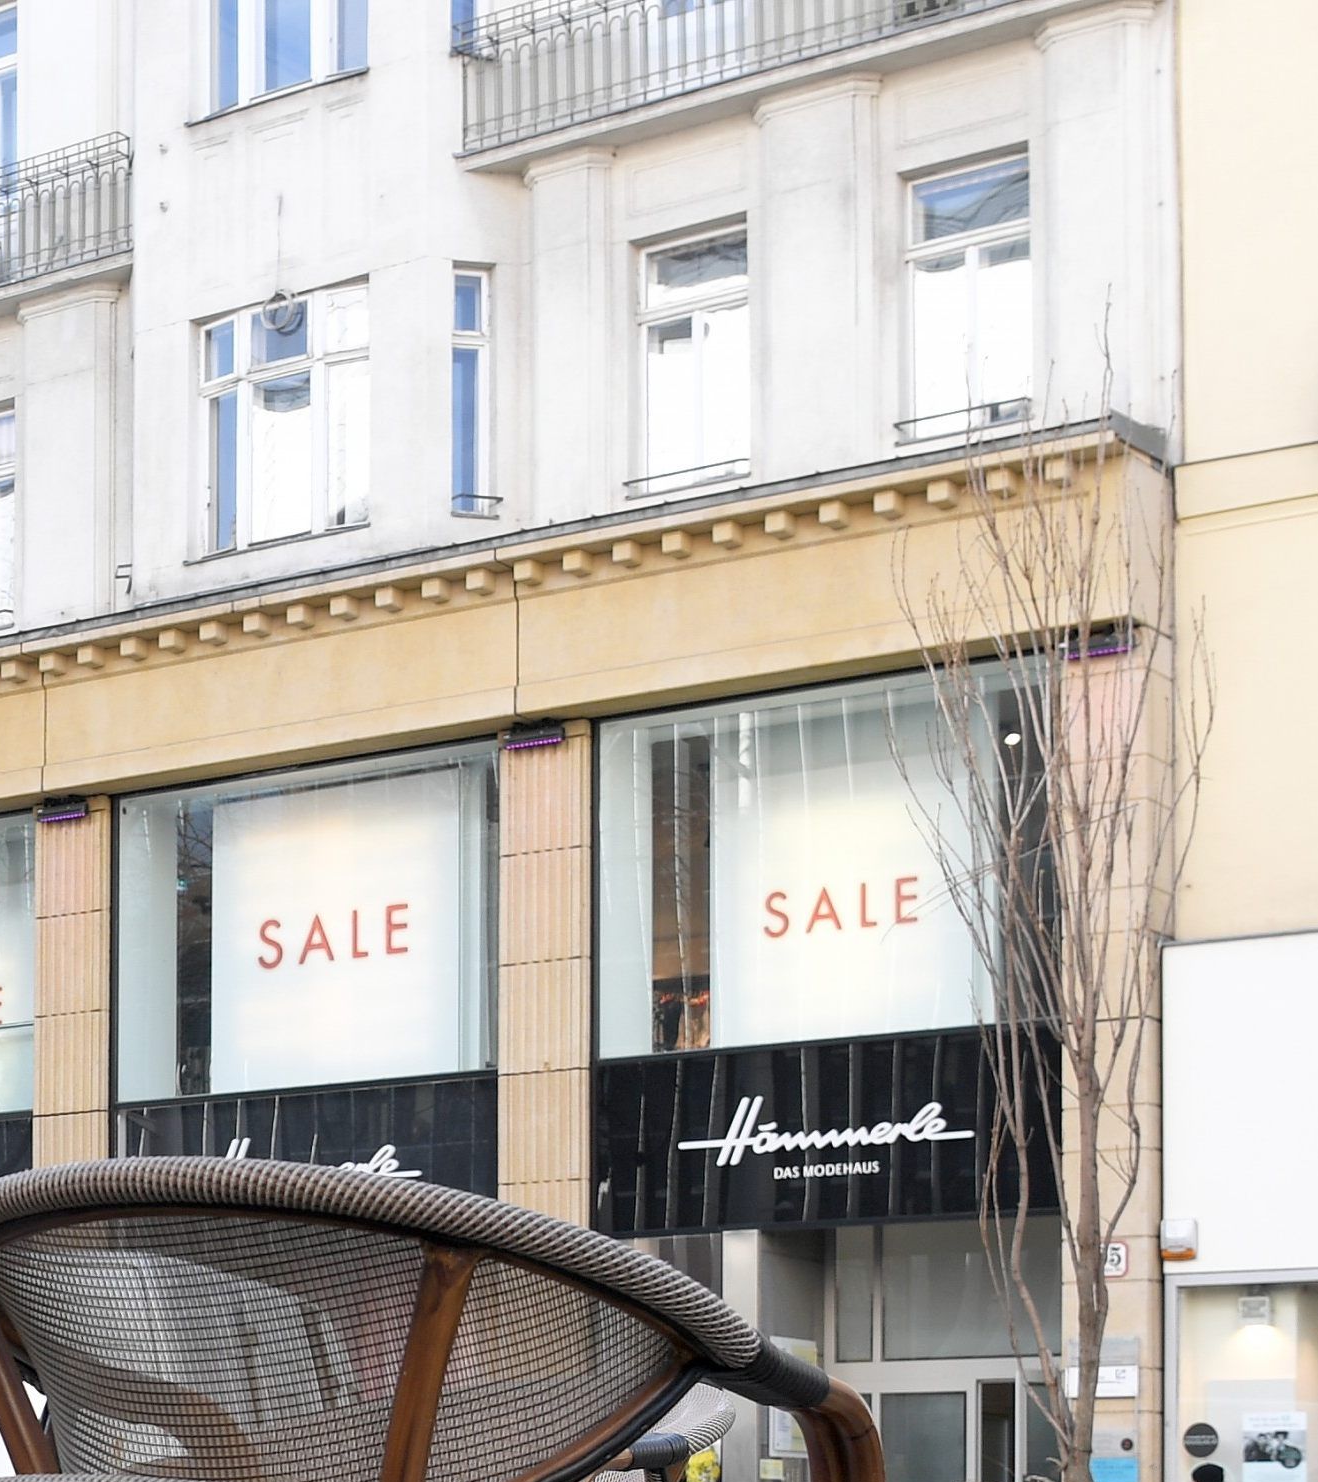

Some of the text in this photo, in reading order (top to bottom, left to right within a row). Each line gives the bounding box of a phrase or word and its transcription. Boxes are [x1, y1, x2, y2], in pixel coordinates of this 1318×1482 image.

[258, 903, 408, 970] SALE
[763, 876, 919, 939] SALE
[773, 1161, 880, 1180] DAS MODEHAUS
